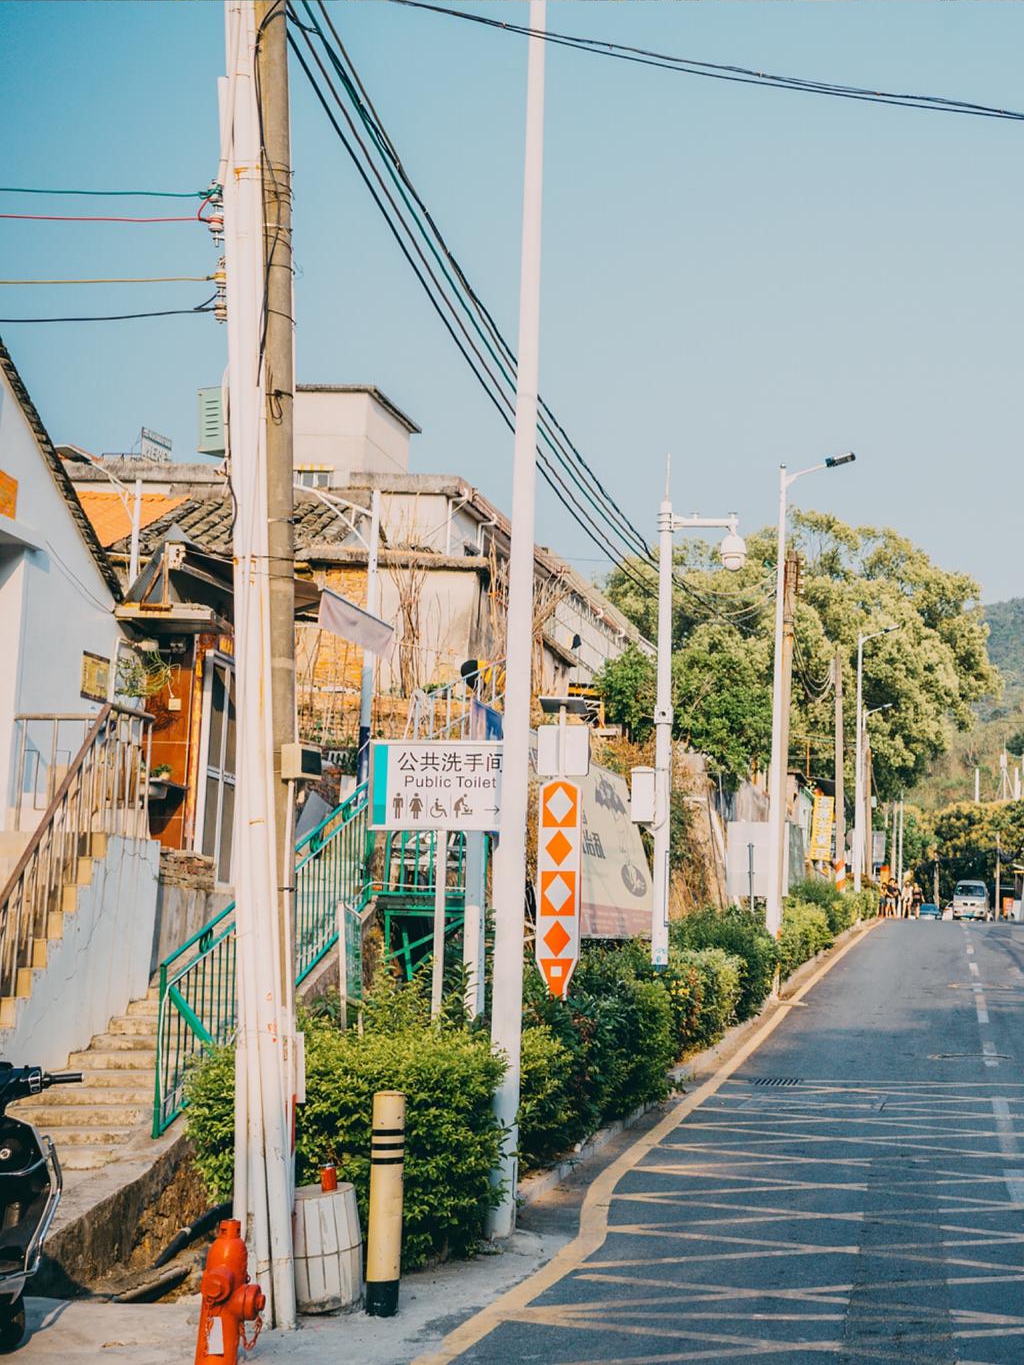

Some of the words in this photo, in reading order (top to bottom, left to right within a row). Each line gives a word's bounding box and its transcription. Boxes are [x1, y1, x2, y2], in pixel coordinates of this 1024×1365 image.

[398, 751, 503, 773] 公共洗手间
[404, 775, 451, 788] Public
[456, 775, 497, 789] Toilet
